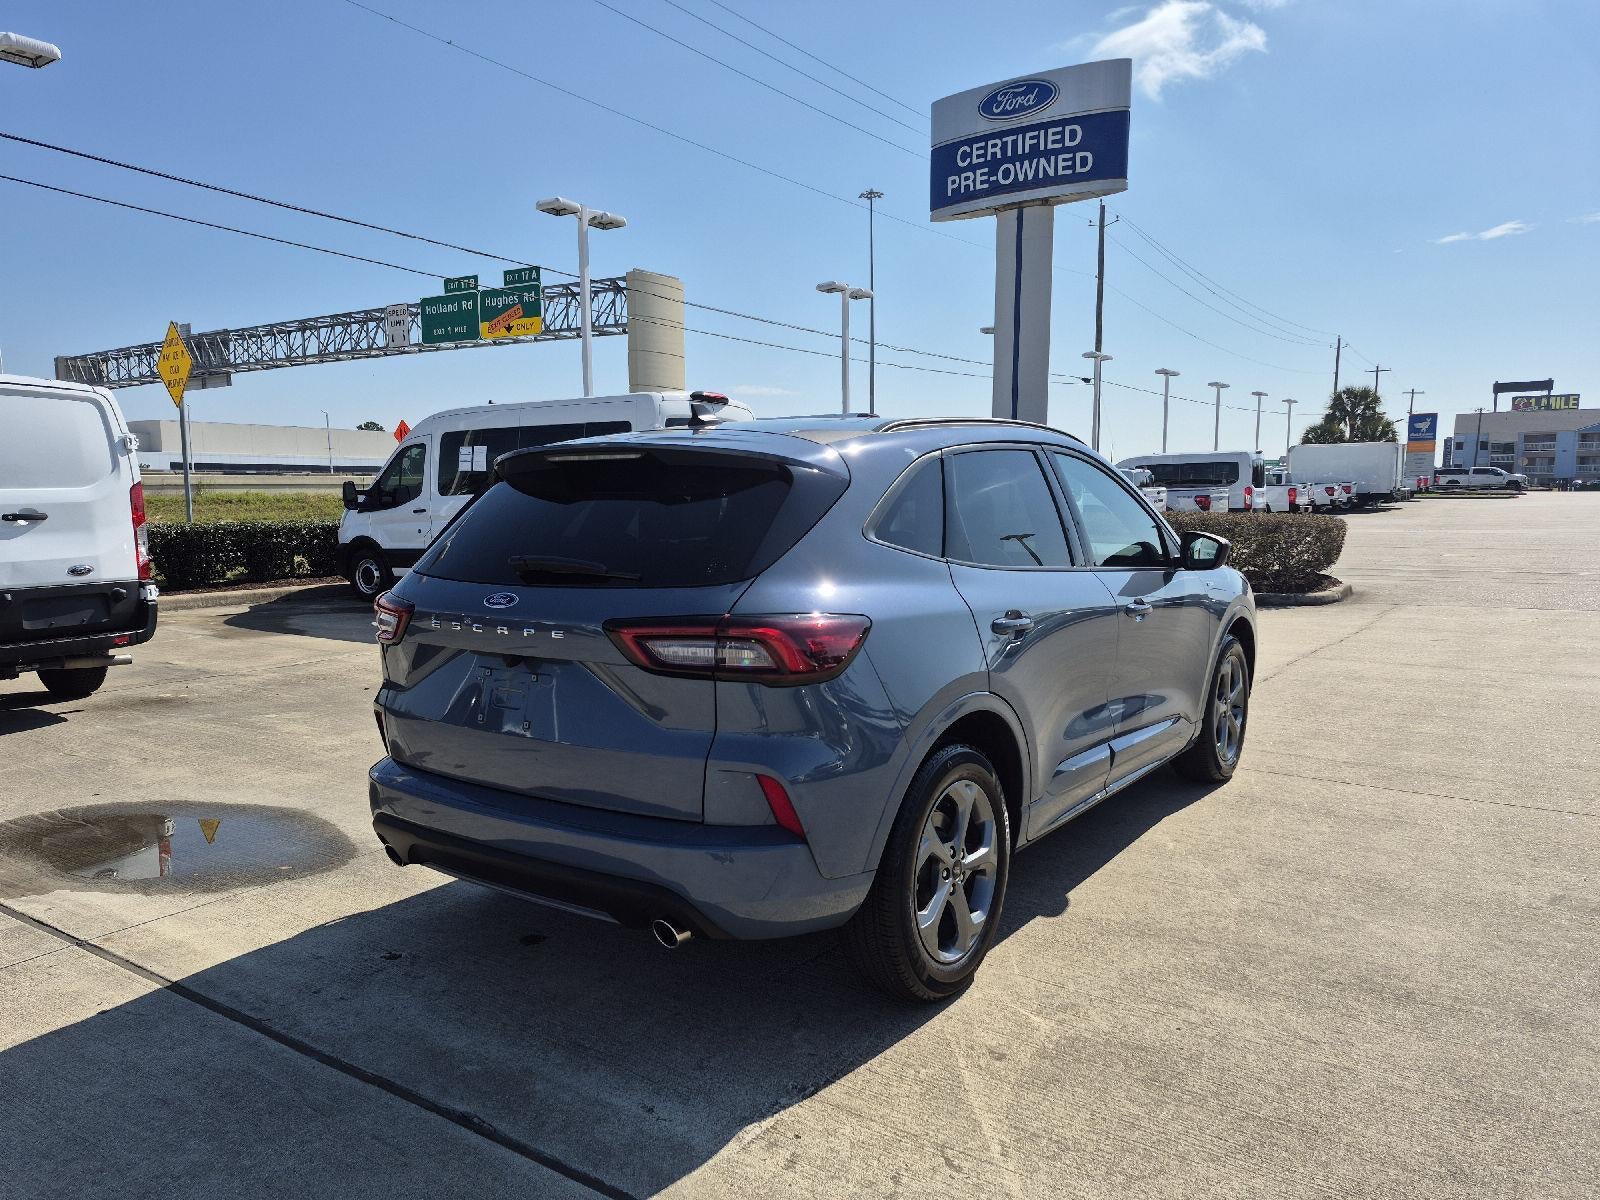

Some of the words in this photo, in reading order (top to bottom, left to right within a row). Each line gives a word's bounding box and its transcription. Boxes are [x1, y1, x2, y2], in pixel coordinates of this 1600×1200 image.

[992, 85, 1039, 114] Ford
[956, 124, 1083, 168] CERTIFIED
[947, 151, 1094, 197] PRE-OWNED
[506, 273, 518, 282] EXIT
[447, 282, 459, 290] EXIT
[485, 294, 519, 308] Hughes
[523, 291, 535, 302] Rd
[388, 308, 407, 317] SPEED
[426, 303, 458, 315] Holland
[462, 299, 473, 311] Rd
[391, 319, 405, 328] LIMIT
[454, 325, 467, 333] MILE
[516, 322, 535, 331] ONLY
[431, 619, 565, 639] ESCAPE
